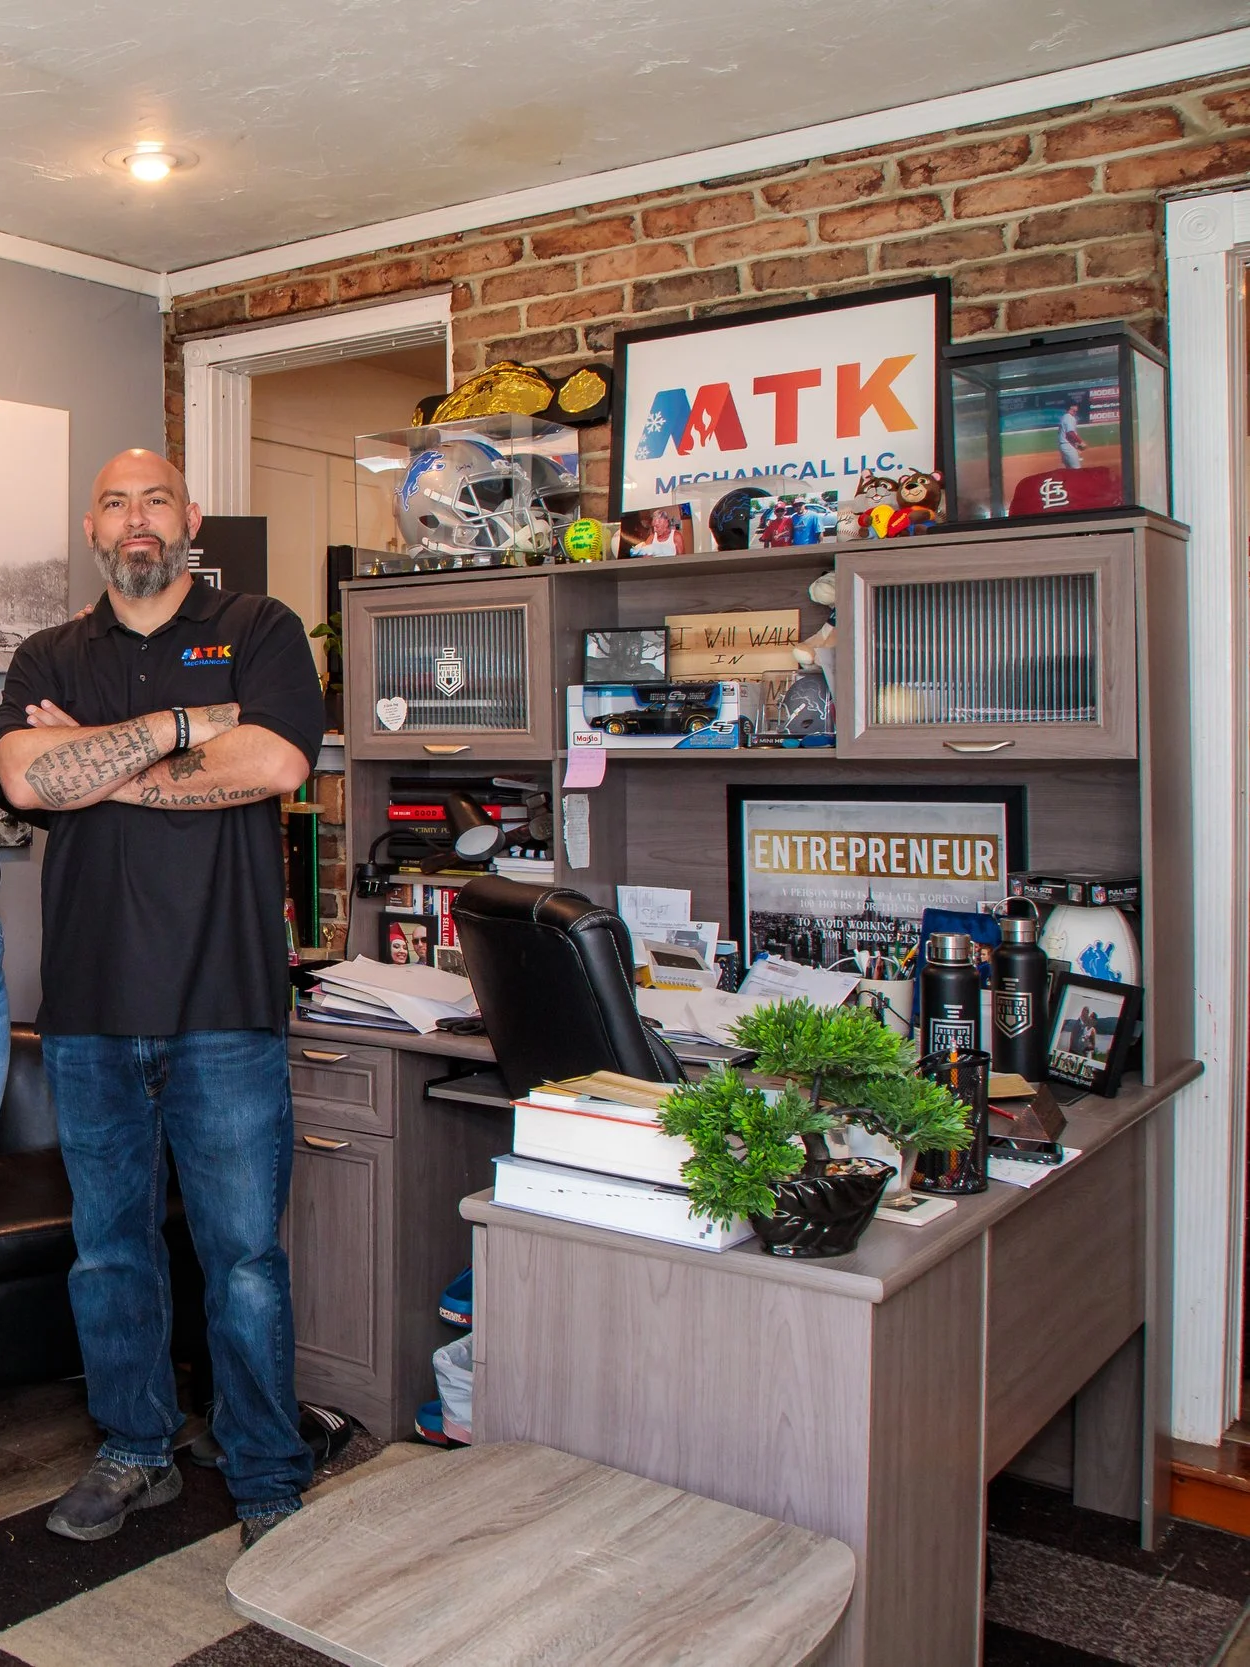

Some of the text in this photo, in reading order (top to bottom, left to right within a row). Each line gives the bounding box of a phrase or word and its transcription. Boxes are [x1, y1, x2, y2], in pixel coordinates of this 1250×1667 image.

[634, 354, 918, 460] MTK
[844, 452, 904, 476] LLC.
[748, 626, 796, 647] WALK
[181, 645, 232, 660] MTK
[710, 654, 744, 664] IN
[576, 734, 598, 744] Maisto
[754, 835, 995, 877] ENTREPRENEUR
[790, 888, 828, 898] PERSON
[832, 889, 856, 900] WHO
[919, 893, 968, 904] WORKING
[800, 899, 876, 912] 100 HOURS FOR
[798, 917, 810, 928] TO
[814, 918, 844, 929] AVOID
[849, 919, 894, 932] WORKING
[823, 929, 840, 940] FOR
[846, 931, 892, 943] SOMEONE
[998, 1006, 1027, 1015] KINGS
[934, 1035, 970, 1045] KINGS
